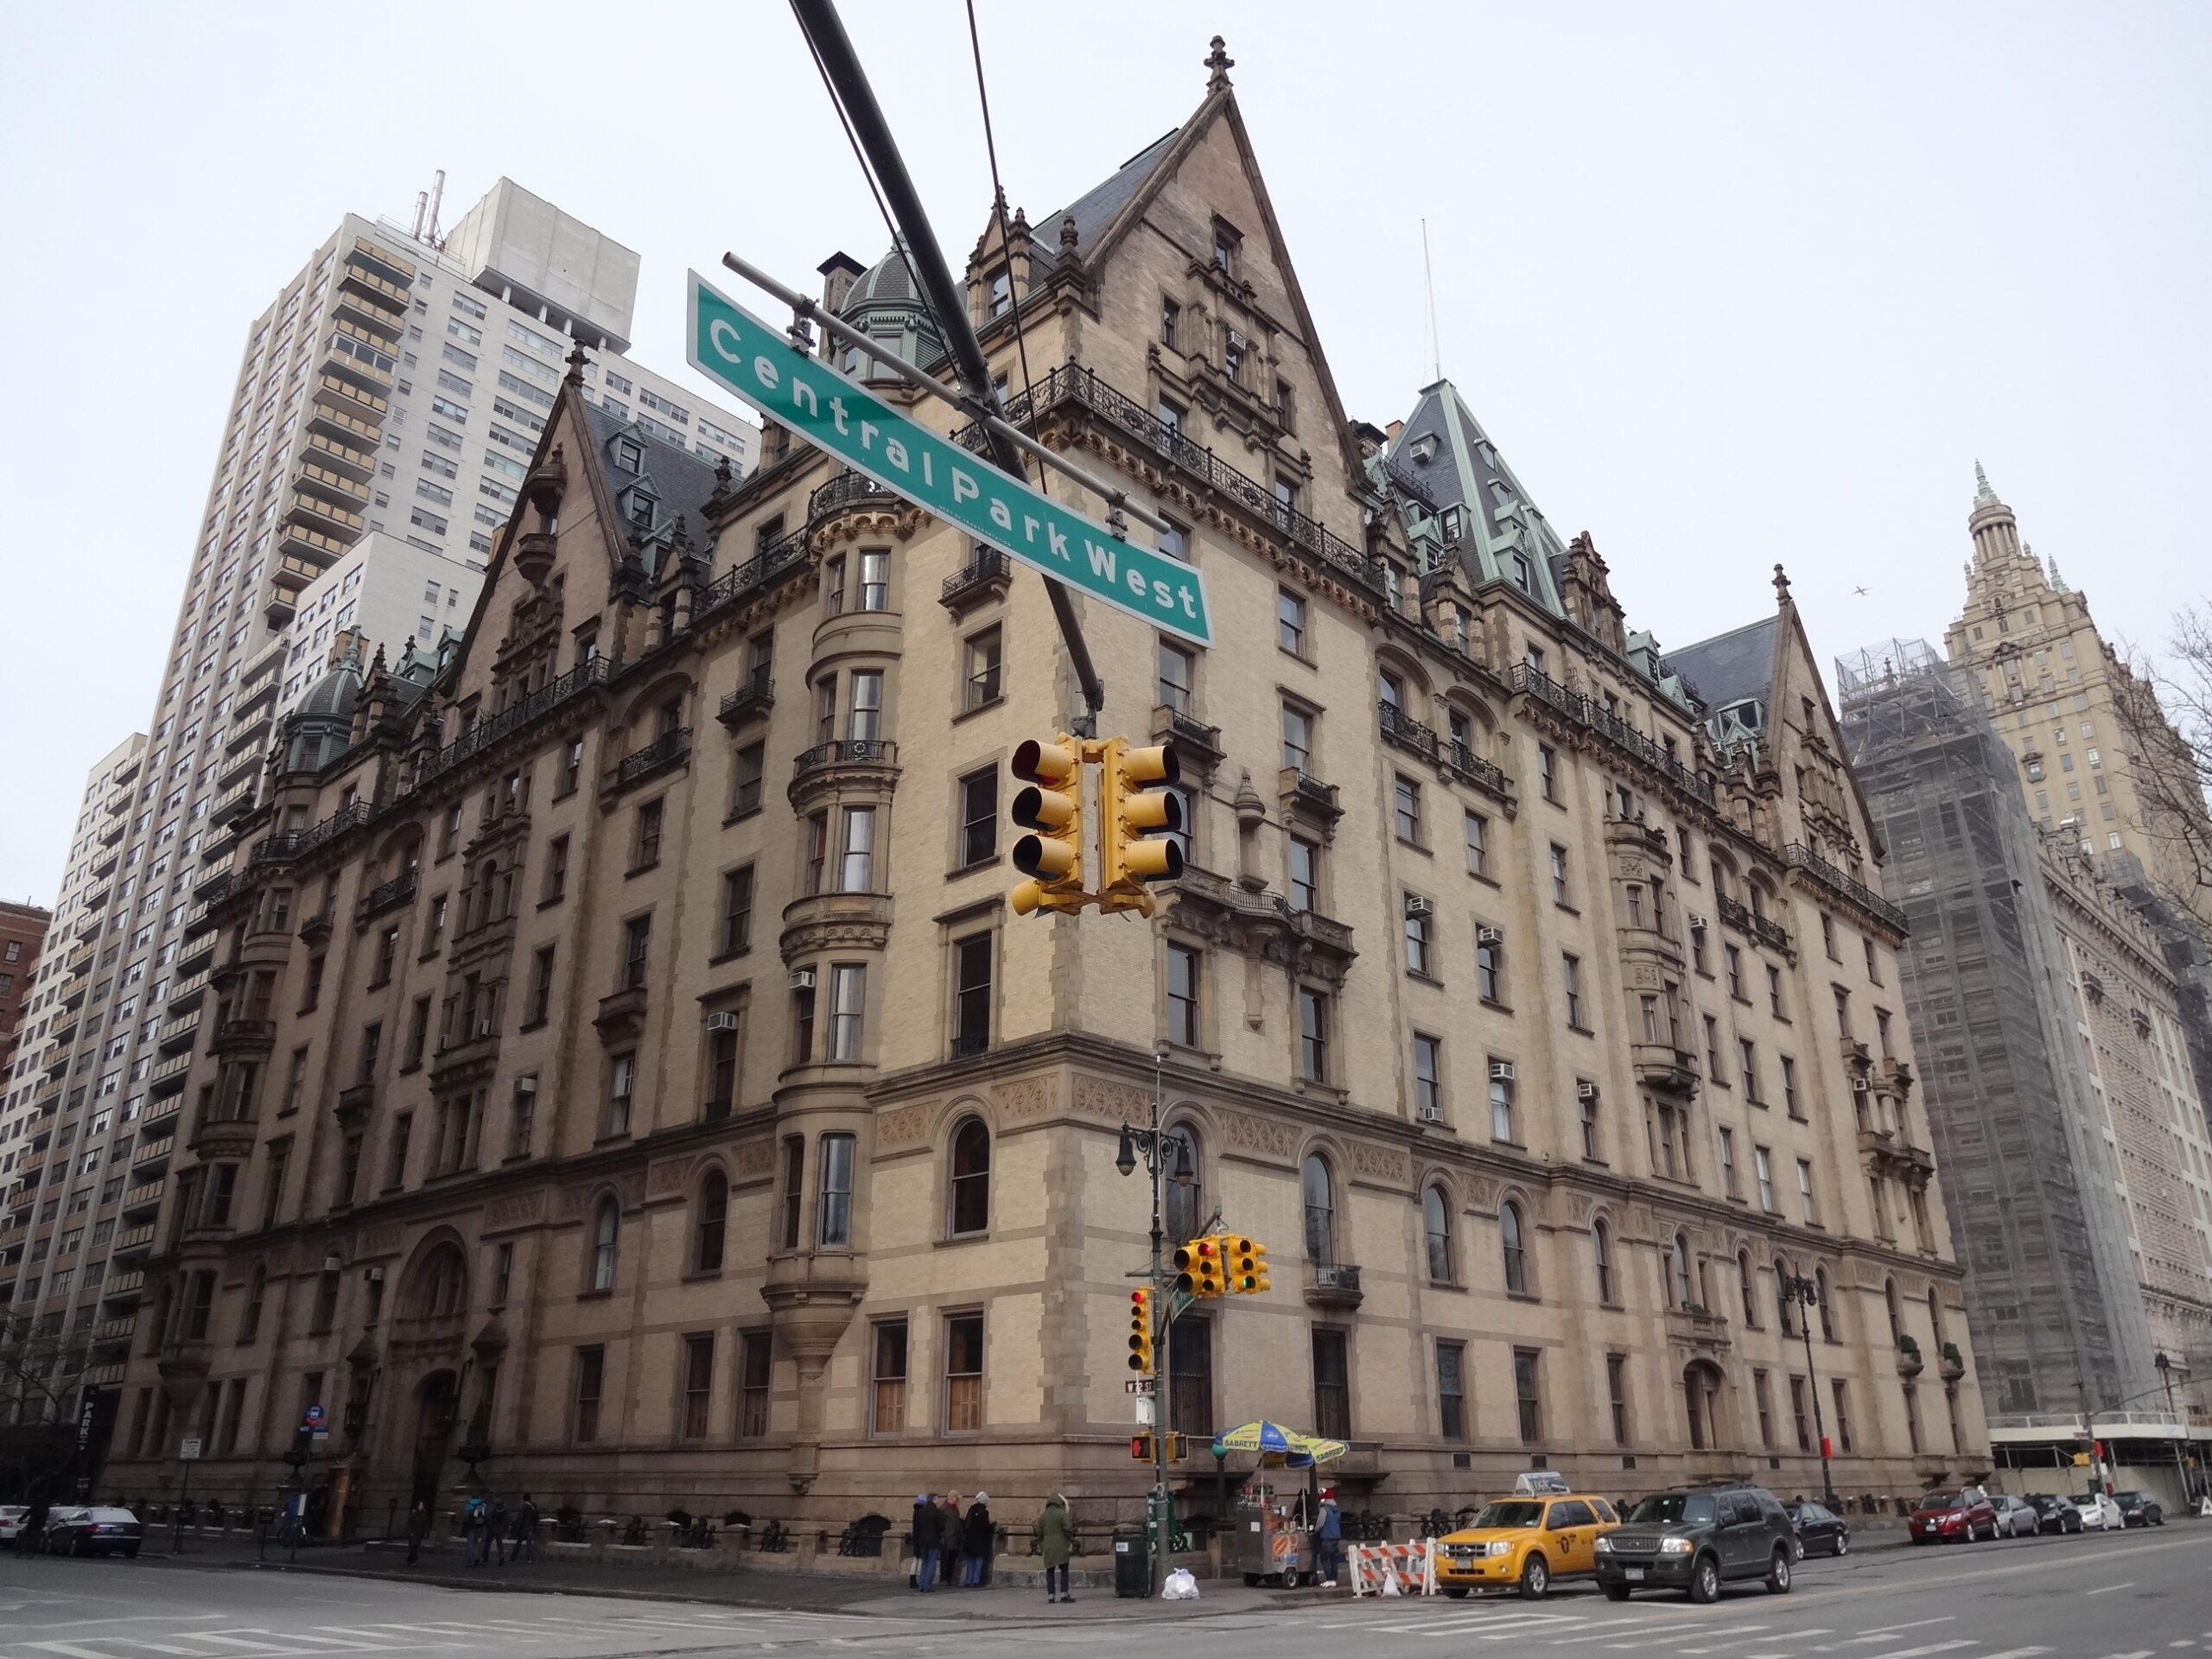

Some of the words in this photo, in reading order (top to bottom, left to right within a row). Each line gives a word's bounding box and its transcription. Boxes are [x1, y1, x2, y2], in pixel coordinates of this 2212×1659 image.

[709, 318, 934, 486] Central
[951, 467, 1071, 562] Park
[1084, 538, 1197, 619] West
[1127, 1382, 1134, 1393] W
[1144, 1382, 1153, 1392] ST
[79, 1402, 94, 1435] PARK
[1224, 1439, 1258, 1448] SABRETT
